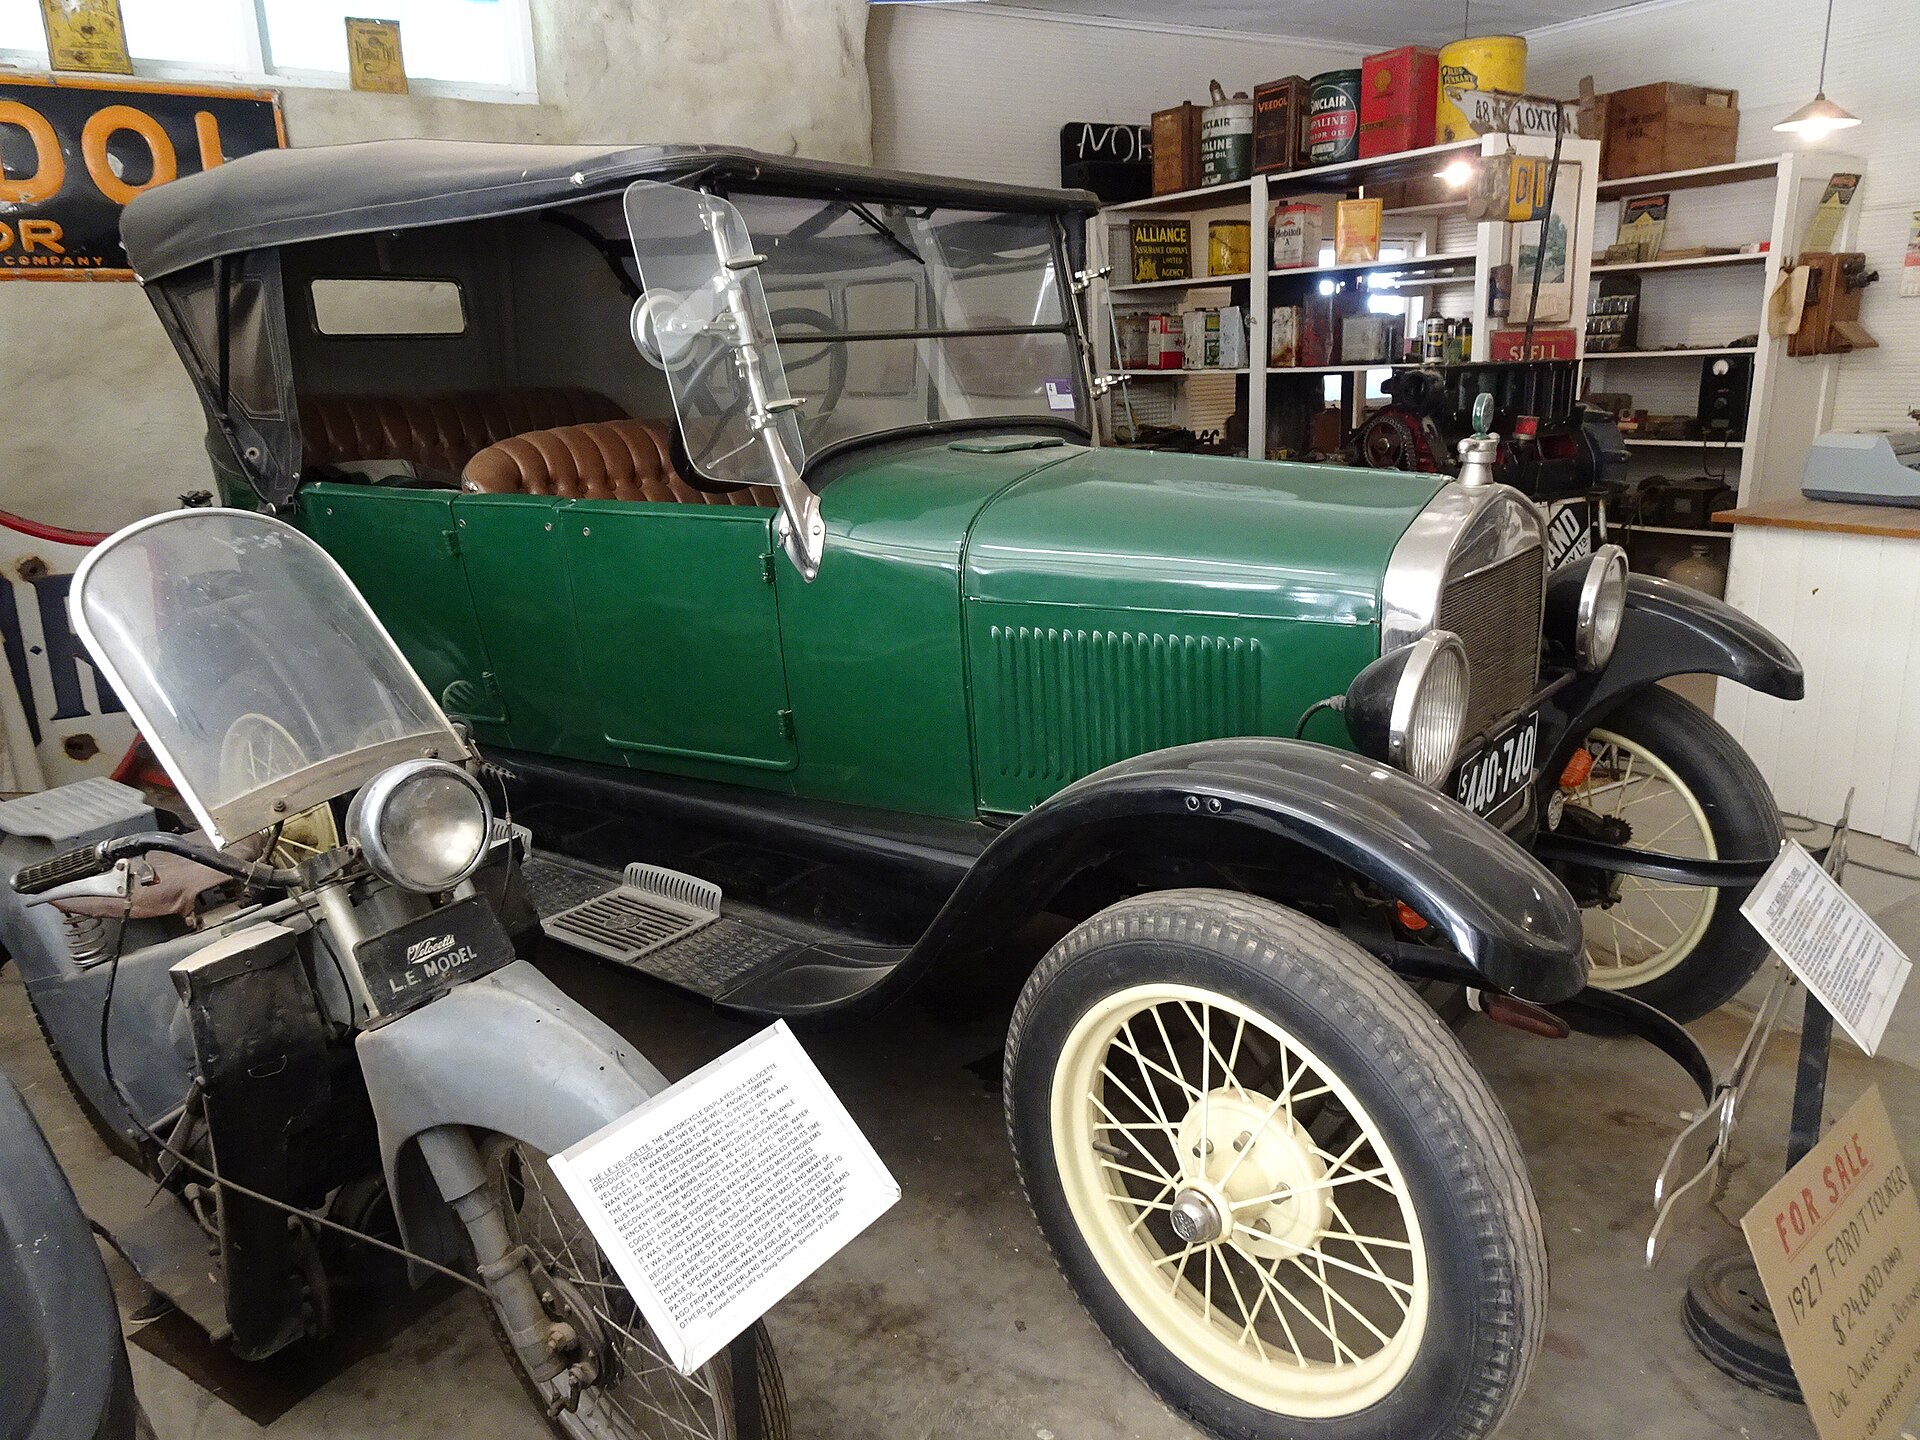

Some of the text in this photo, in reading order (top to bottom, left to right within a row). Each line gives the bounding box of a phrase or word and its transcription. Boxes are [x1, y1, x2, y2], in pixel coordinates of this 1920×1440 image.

[1215, 151, 1227, 160] OIL
[1258, 97, 1287, 113] VEEDOL
[3, 255, 103, 267] COMPANY
[1135, 227, 1187, 242] ALLIANCE
[423, 945, 478, 977] MODEL
[588, 1062, 777, 1185] THE THE MOTORCYCLE DISPLAYED VELOCETTE
[592, 1165, 631, 1193] PRODUCED
[638, 1142, 668, 1164] ENGLAND
[696, 1115, 709, 1127] THE
[708, 1106, 725, 1119] WELL
[597, 1087, 769, 1201] VELOCE WAS DESIGNED APPEAL PEOPLE WHO
[602, 1083, 788, 1209] WANTED QUIET REFINED NOT NOISY AND WAS
[608, 1135, 726, 1216] THE ONE ITS DESIGNERS WAS
[612, 1098, 795, 1225] AUSTRALIAN WARTIME WHO DREW PLANS WHILE
[617, 1112, 789, 1233] RECOVERING FROM BOMB ALSO DESIGNED THE
[622, 1108, 809, 1241] VINCENT THE MOTORCYCLE HAS WATER
[627, 1121, 804, 1249] COOLED SHAFT DRIVE THE REAR BOTH THE
[632, 1135, 799, 1256] FRONT AND REAR SUSPENSION WAS QUITE ADVANCED FOR
[647, 1172, 791, 1280] BECOMING SELL GREAT
[652, 1180, 795, 1288] HOWEVER SOME SIXTEEN THOUSAND WERE MADE
[660, 1150, 793, 1248] PLEASANT SLOW MINOR
[663, 1170, 835, 1305] CHASE SPEADING CONSTABLES STREET
[665, 1238, 686, 1256] MORE
[714, 1205, 732, 1220] THAN
[743, 1175, 773, 1199] JAPANESE
[772, 1146, 813, 1178] MOTORCYCLES
[696, 1169, 850, 1291] THIS MACHINE BOUGHT DONOR SOME YEARS
[1774, 1132, 1869, 1255] FOR SALE
[658, 1276, 681, 1296] THESE
[679, 1262, 700, 1280] WERE
[699, 1249, 718, 1265] SOLD
[729, 1226, 748, 1243] USED
[779, 1186, 801, 1204] POLICE
[678, 1217, 817, 1329] OTHERS RIVERLAND INCLUDING ANOTHER
[689, 1183, 846, 1309] FROM ENGLISHMAN THERE SEVERAL
[1787, 1264, 1823, 1326] 1927
[1826, 1221, 1861, 1278] FORD
